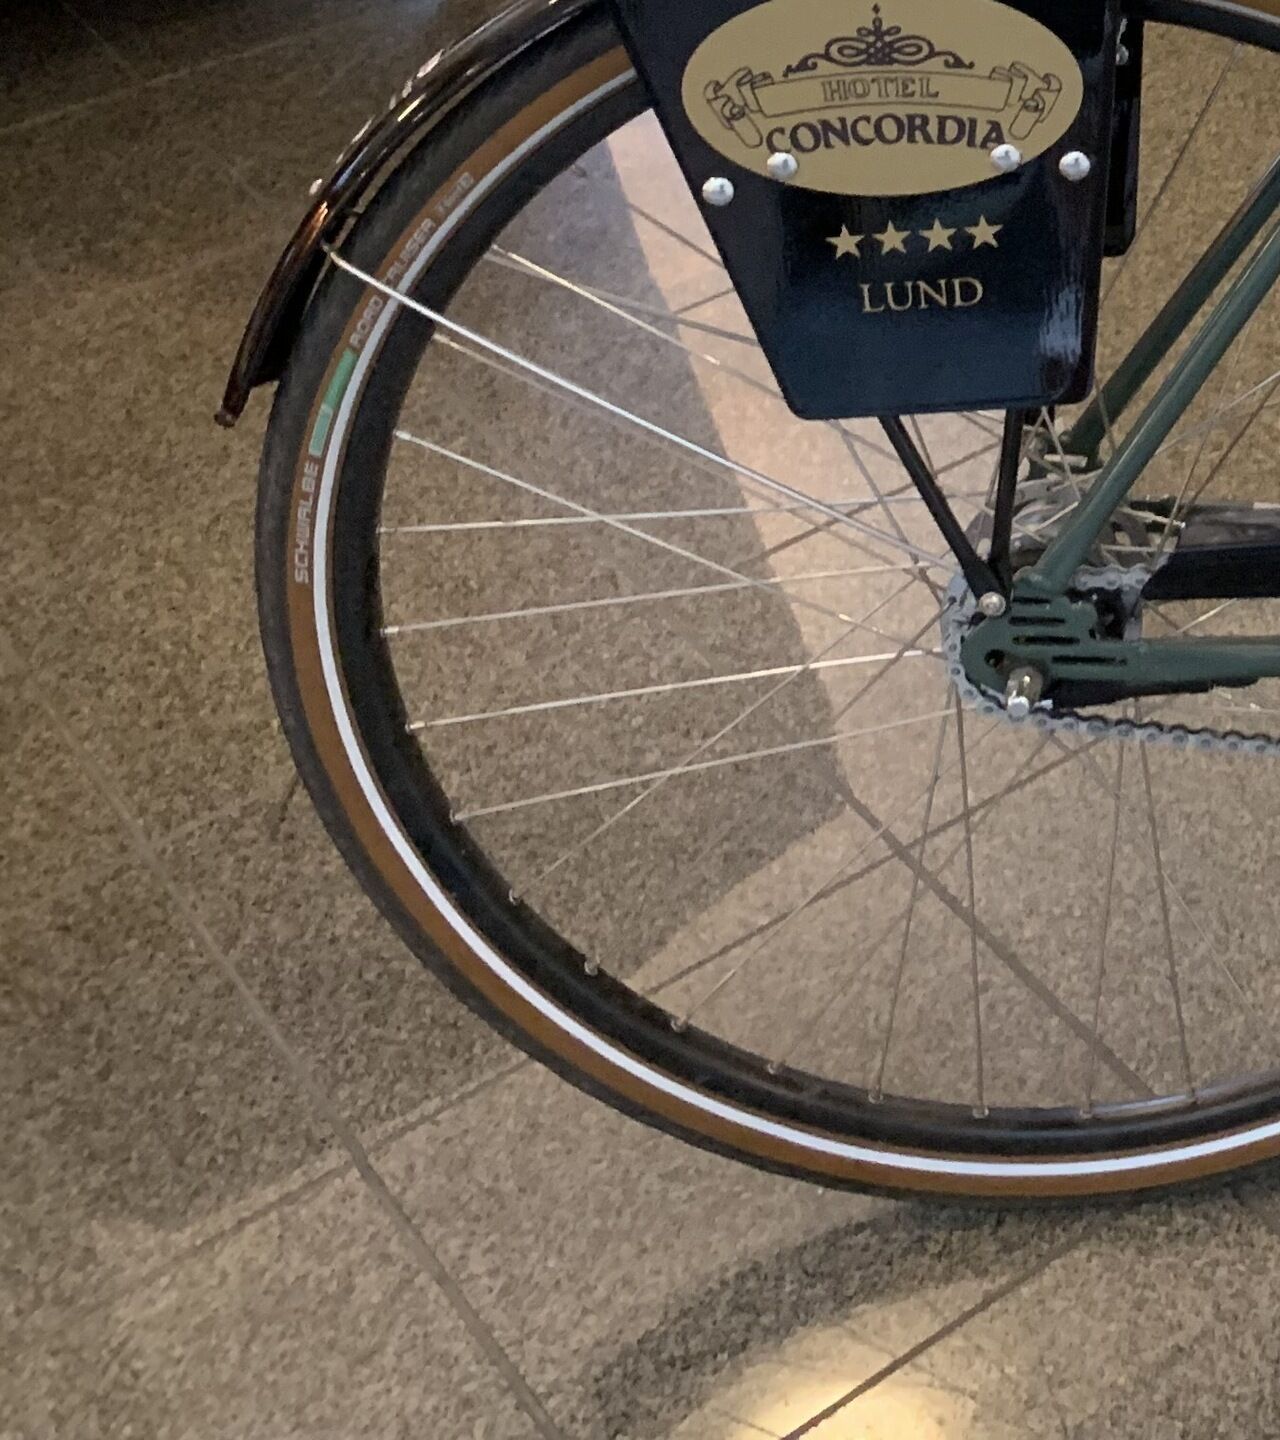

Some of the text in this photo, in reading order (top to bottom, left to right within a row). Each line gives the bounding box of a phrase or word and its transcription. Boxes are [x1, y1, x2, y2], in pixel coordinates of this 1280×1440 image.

[821, 76, 940, 104] HOTEL
[765, 112, 1008, 155] CONCORDIA
[859, 276, 984, 313] LUND
[294, 461, 320, 585] SCHWALBE
